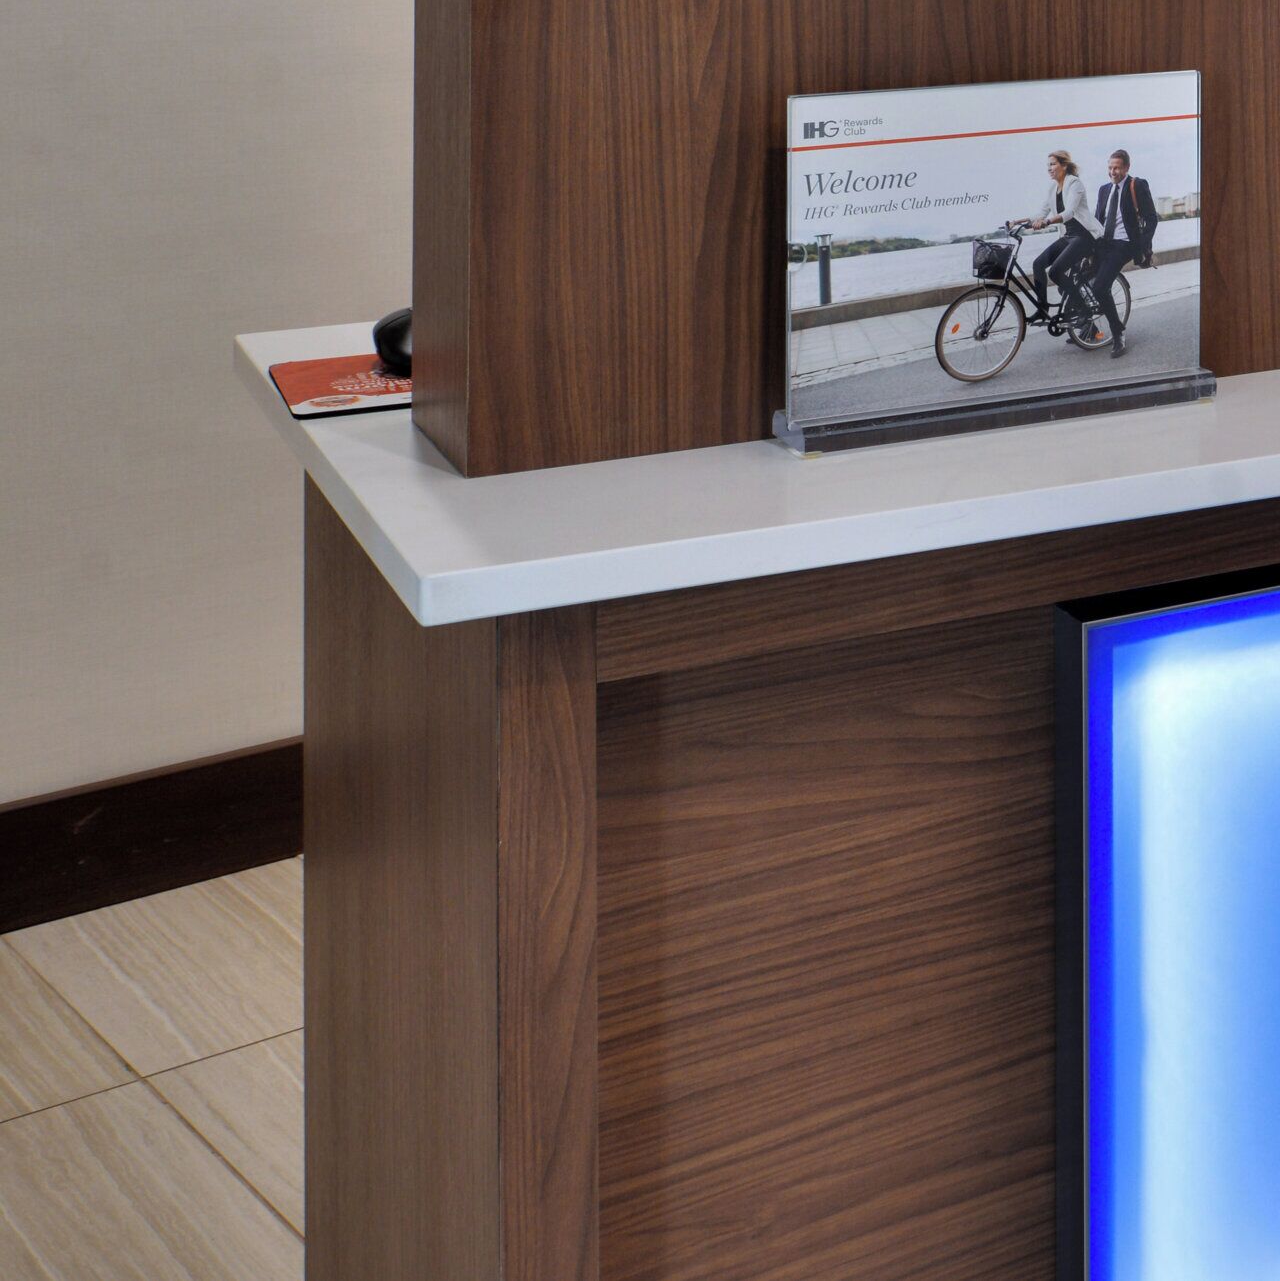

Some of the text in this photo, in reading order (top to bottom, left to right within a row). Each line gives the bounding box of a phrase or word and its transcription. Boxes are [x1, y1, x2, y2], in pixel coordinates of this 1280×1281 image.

[803, 117, 883, 139] IHG Rewards
[843, 127, 866, 136] Club
[803, 170, 918, 197] Welcome
[843, 200, 898, 217] Rewards
[901, 196, 931, 211] Club
[934, 192, 990, 208] members
